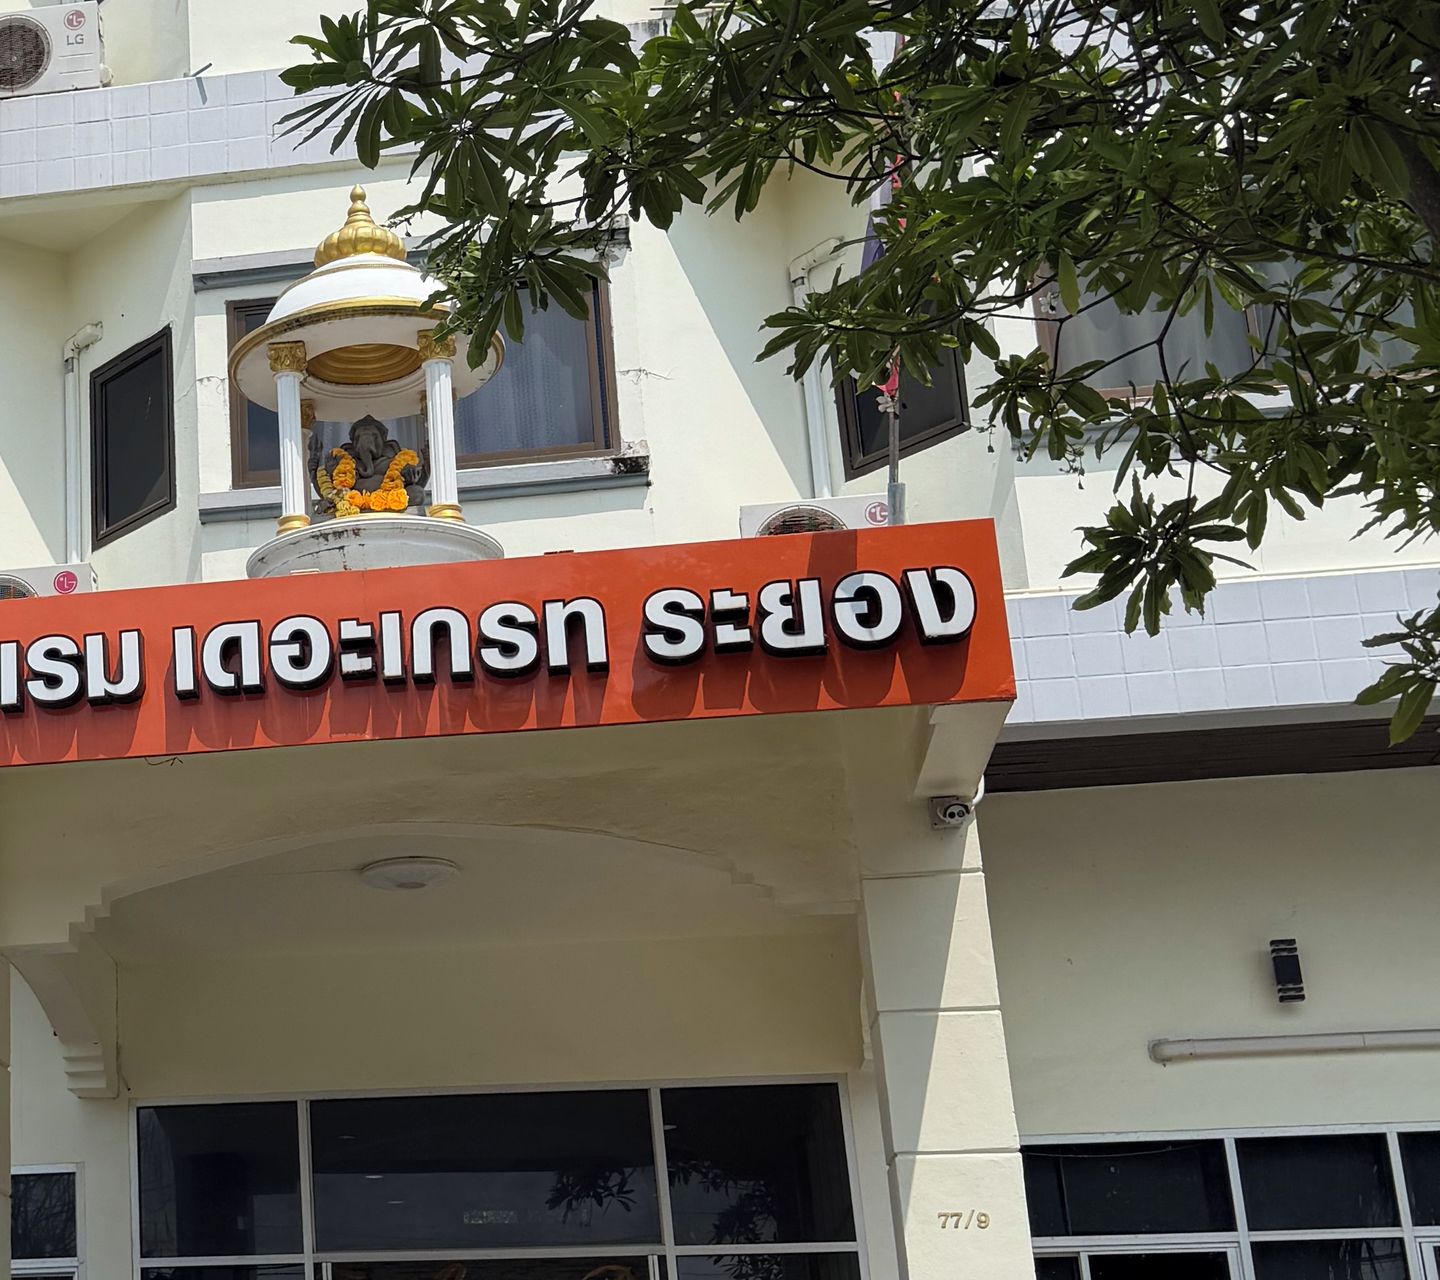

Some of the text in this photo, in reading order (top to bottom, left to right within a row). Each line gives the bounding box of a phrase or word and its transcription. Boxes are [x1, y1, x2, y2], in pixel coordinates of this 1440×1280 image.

[66, 33, 85, 46] LG
[172, 596, 609, 699] เดอะเกรท
[642, 566, 976, 666] ระยอง
[937, 1209, 991, 1230] 77/9
